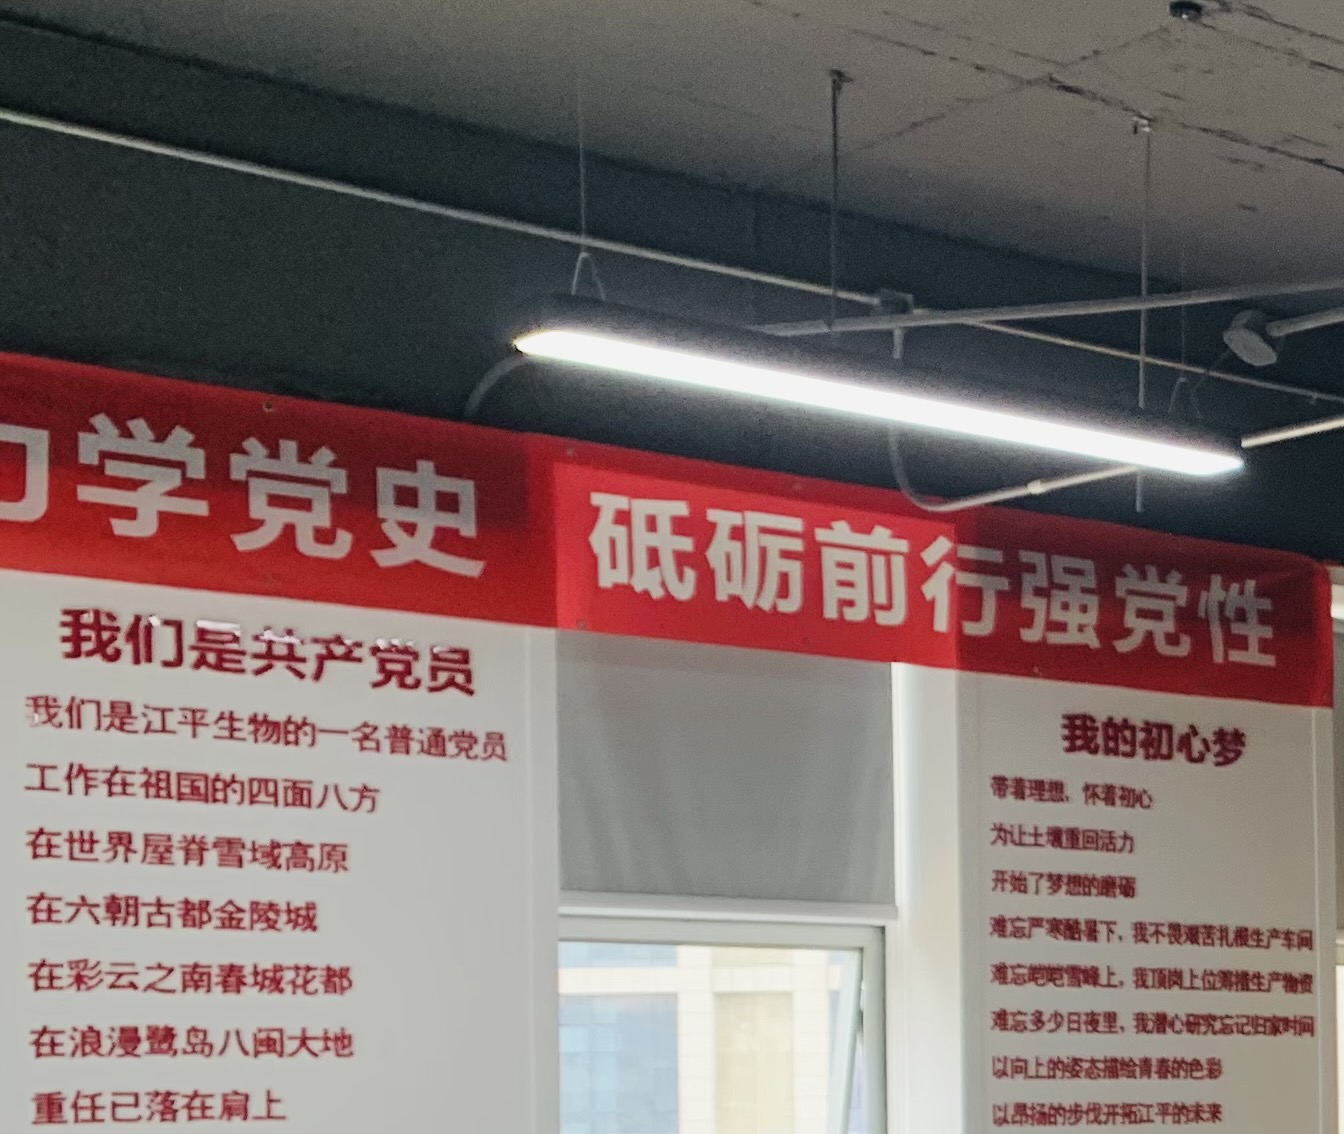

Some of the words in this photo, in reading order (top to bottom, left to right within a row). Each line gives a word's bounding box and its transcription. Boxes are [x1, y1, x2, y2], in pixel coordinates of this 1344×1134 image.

[588, 491, 1278, 668] 砥砺前行强党性
[59, 608, 475, 697] 我们是共产党员
[27, 695, 507, 760] 我们是江平生物的一名普通党员
[1062, 713, 1246, 768] 我的初心梦
[27, 763, 378, 811] 工作在祖国的四面八方
[27, 827, 348, 872] 在世界屋脊雪域高原
[993, 823, 1133, 853] 为让土壤重回活力
[994, 870, 1136, 899] 开始了梦想的磨砺
[28, 892, 318, 932] 在六朝古都金陵城
[29, 959, 353, 996] 在彩云之南春城花都
[32, 1025, 353, 1059] 在浪漫鹭岛八闽大地
[993, 1057, 1223, 1080] 以向上的姿态描绘青春的色彩
[33, 1090, 285, 1125] 重任已落在肩上
[993, 1103, 1223, 1126] 以昂扬的步伐开拓江平的未来
